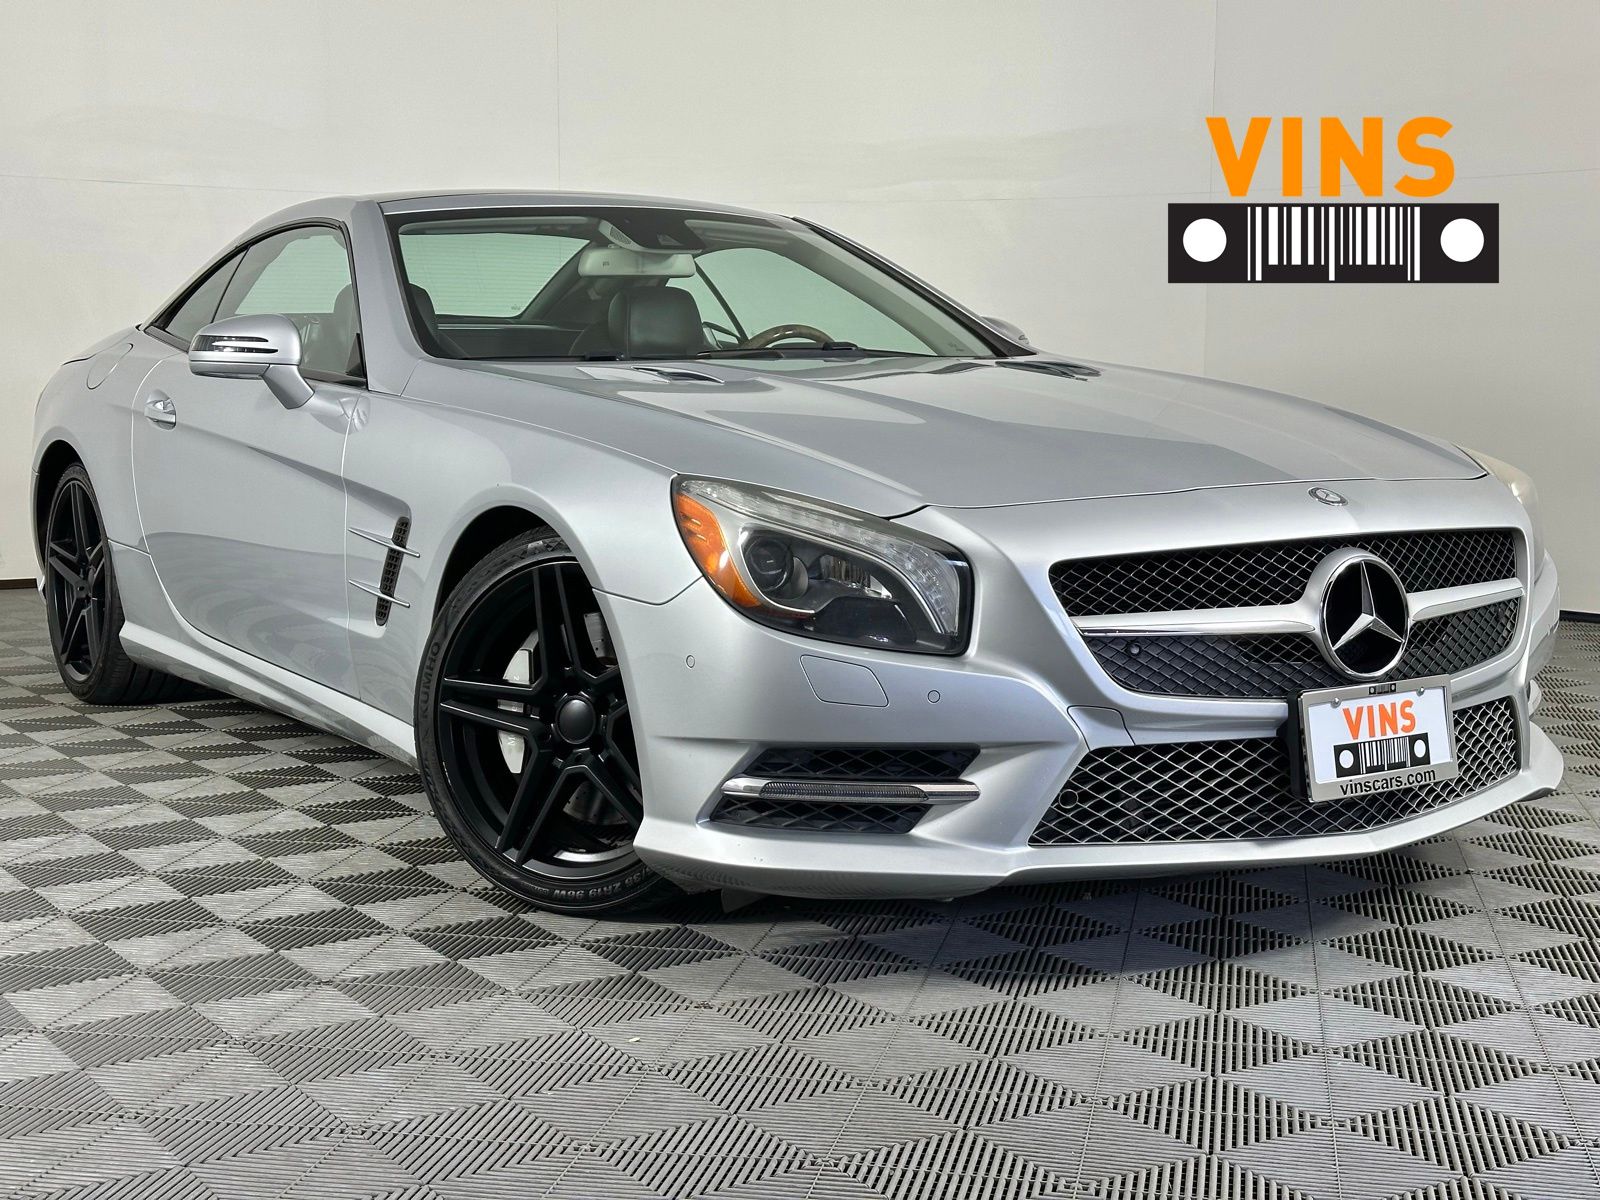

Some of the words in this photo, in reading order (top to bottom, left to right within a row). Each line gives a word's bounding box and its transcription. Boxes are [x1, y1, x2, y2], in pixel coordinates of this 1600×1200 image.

[420, 641, 441, 719] KUMHO
[1342, 699, 1416, 740] VINS
[1339, 769, 1437, 796] vinscars.com
